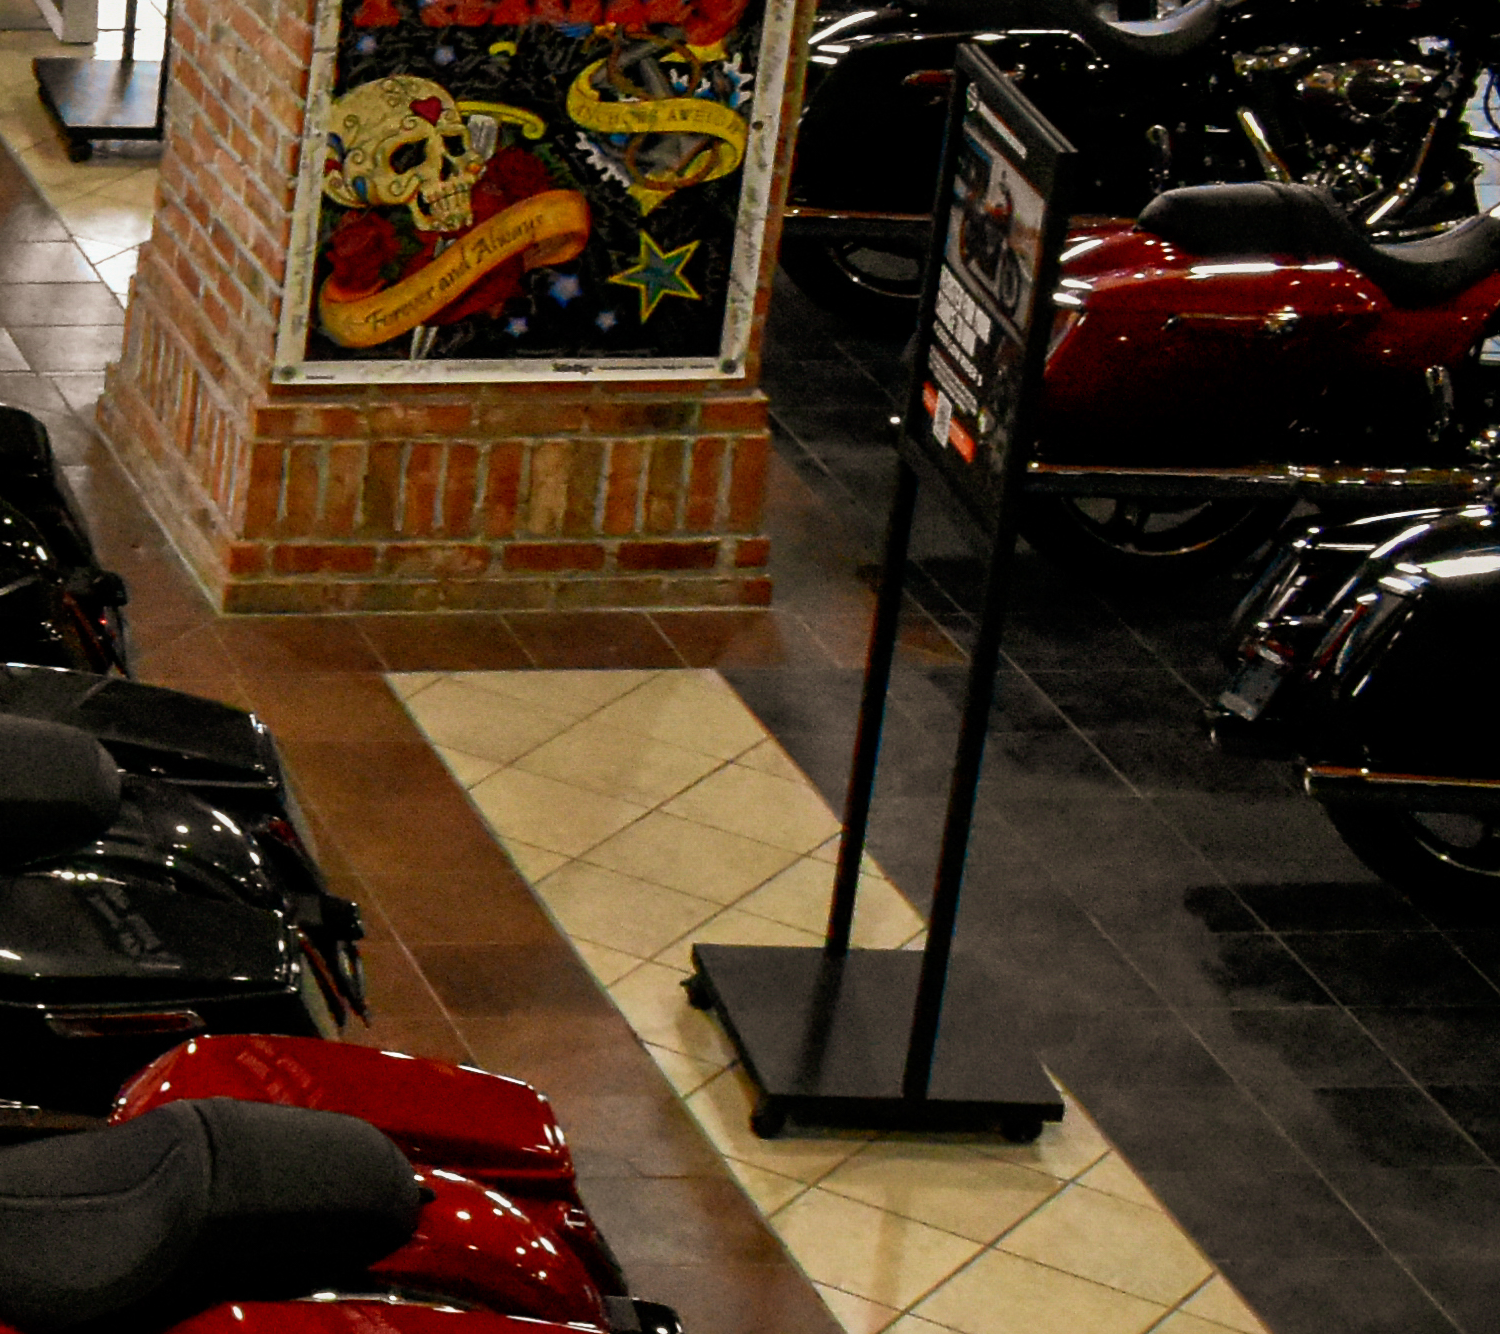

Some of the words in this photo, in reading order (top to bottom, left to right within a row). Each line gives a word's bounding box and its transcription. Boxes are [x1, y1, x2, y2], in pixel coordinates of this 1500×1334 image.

[365, 285, 436, 332] Forever
[438, 246, 472, 291] and
[472, 214, 544, 264] Always
